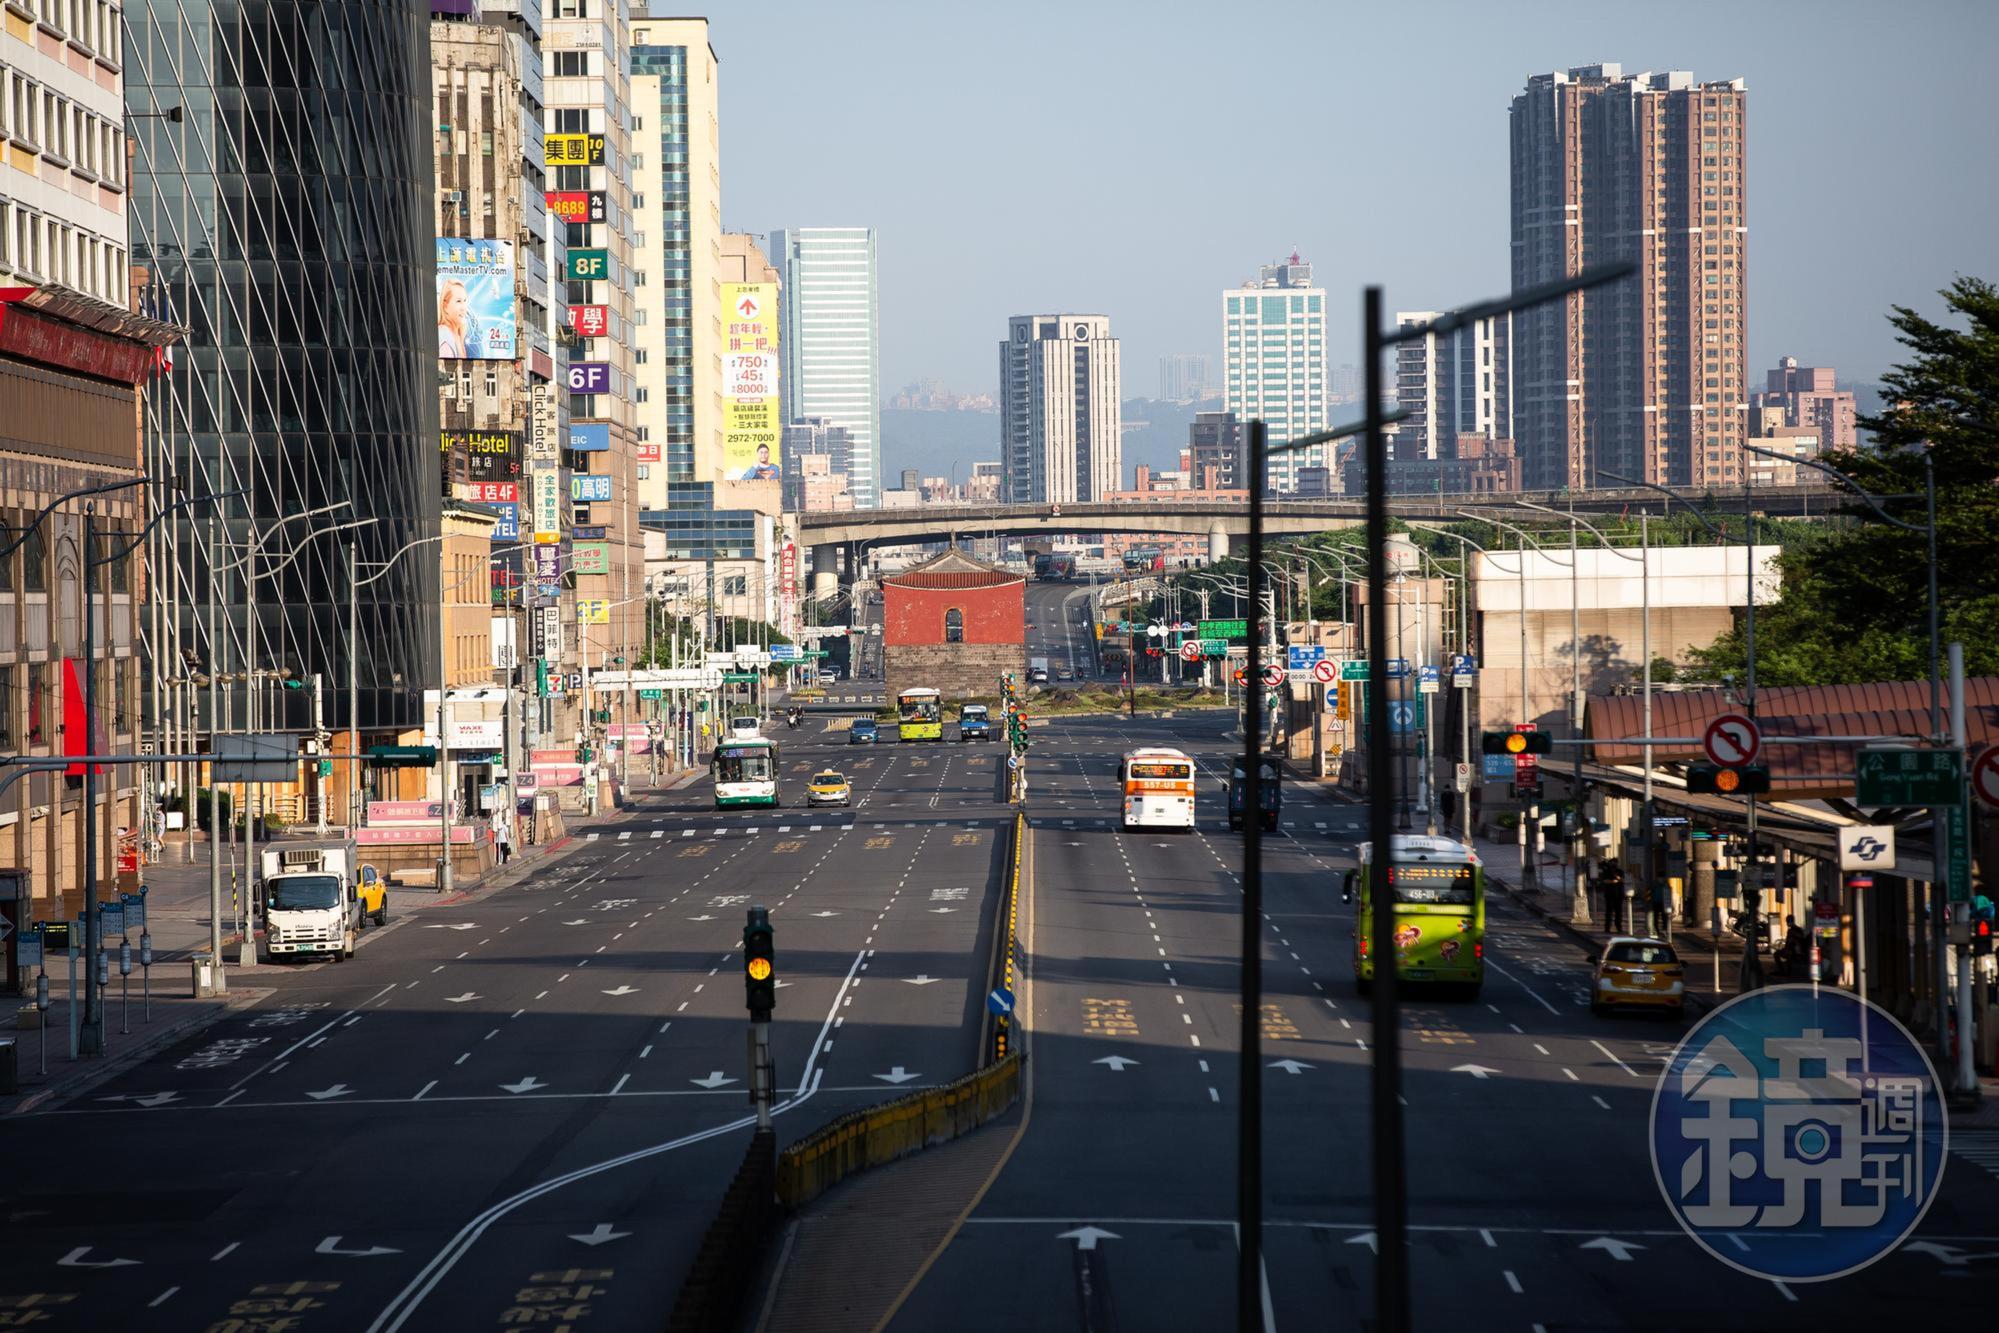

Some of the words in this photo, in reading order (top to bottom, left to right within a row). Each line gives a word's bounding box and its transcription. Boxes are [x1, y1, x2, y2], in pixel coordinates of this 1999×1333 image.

[546, 139, 585, 160] 集團
[589, 139, 603, 149] 10
[592, 195, 603, 219] 九樓
[436, 265, 507, 276] emeMasterTV.com
[575, 258, 602, 275] 8F
[737, 356, 762, 368] 750
[569, 367, 602, 389] 6F
[741, 370, 758, 381] 45
[736, 384, 764, 394] 8000
[534, 386, 547, 415] Click
[468, 433, 509, 453] Hotel
[534, 418, 547, 453] Hotel
[727, 433, 775, 443] 2972-7000
[1868, 753, 1951, 770] 公園路
[519, 776, 534, 785] Z4
